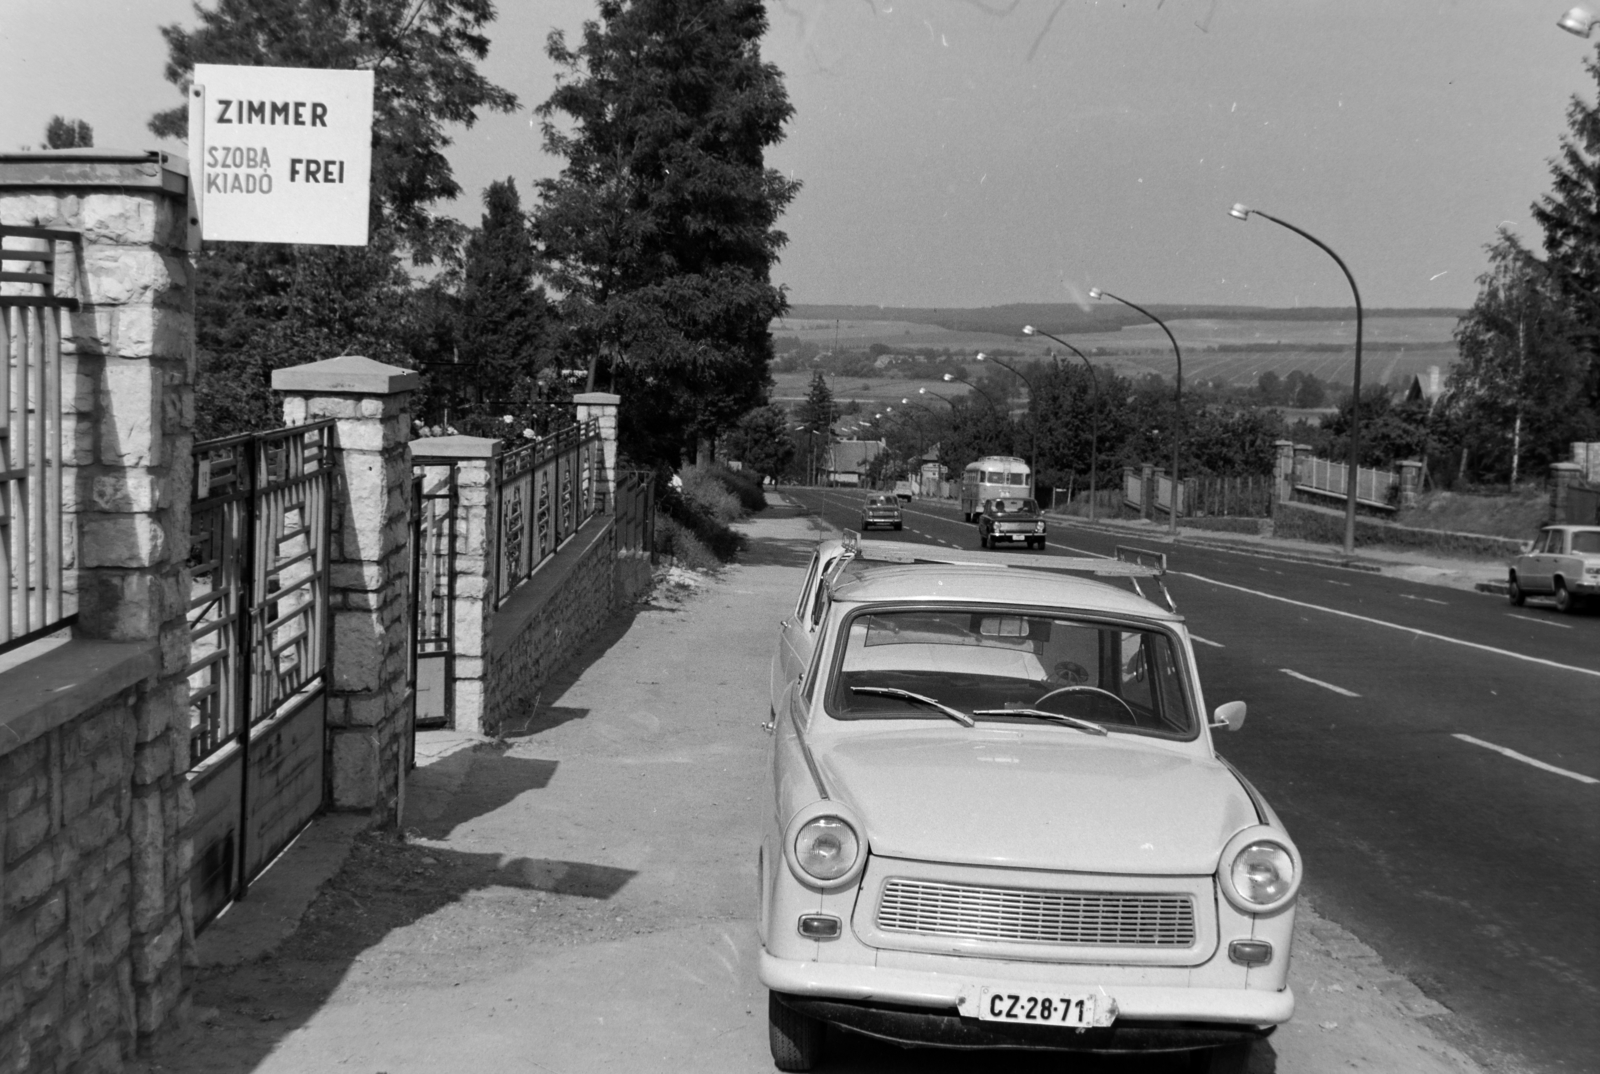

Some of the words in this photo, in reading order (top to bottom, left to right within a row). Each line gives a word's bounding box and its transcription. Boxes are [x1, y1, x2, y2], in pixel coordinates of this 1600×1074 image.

[216, 99, 328, 127] ZIMMER
[206, 146, 271, 169] SZOBA
[206, 168, 273, 194] KIADÓ
[289, 158, 345, 184] FREI
